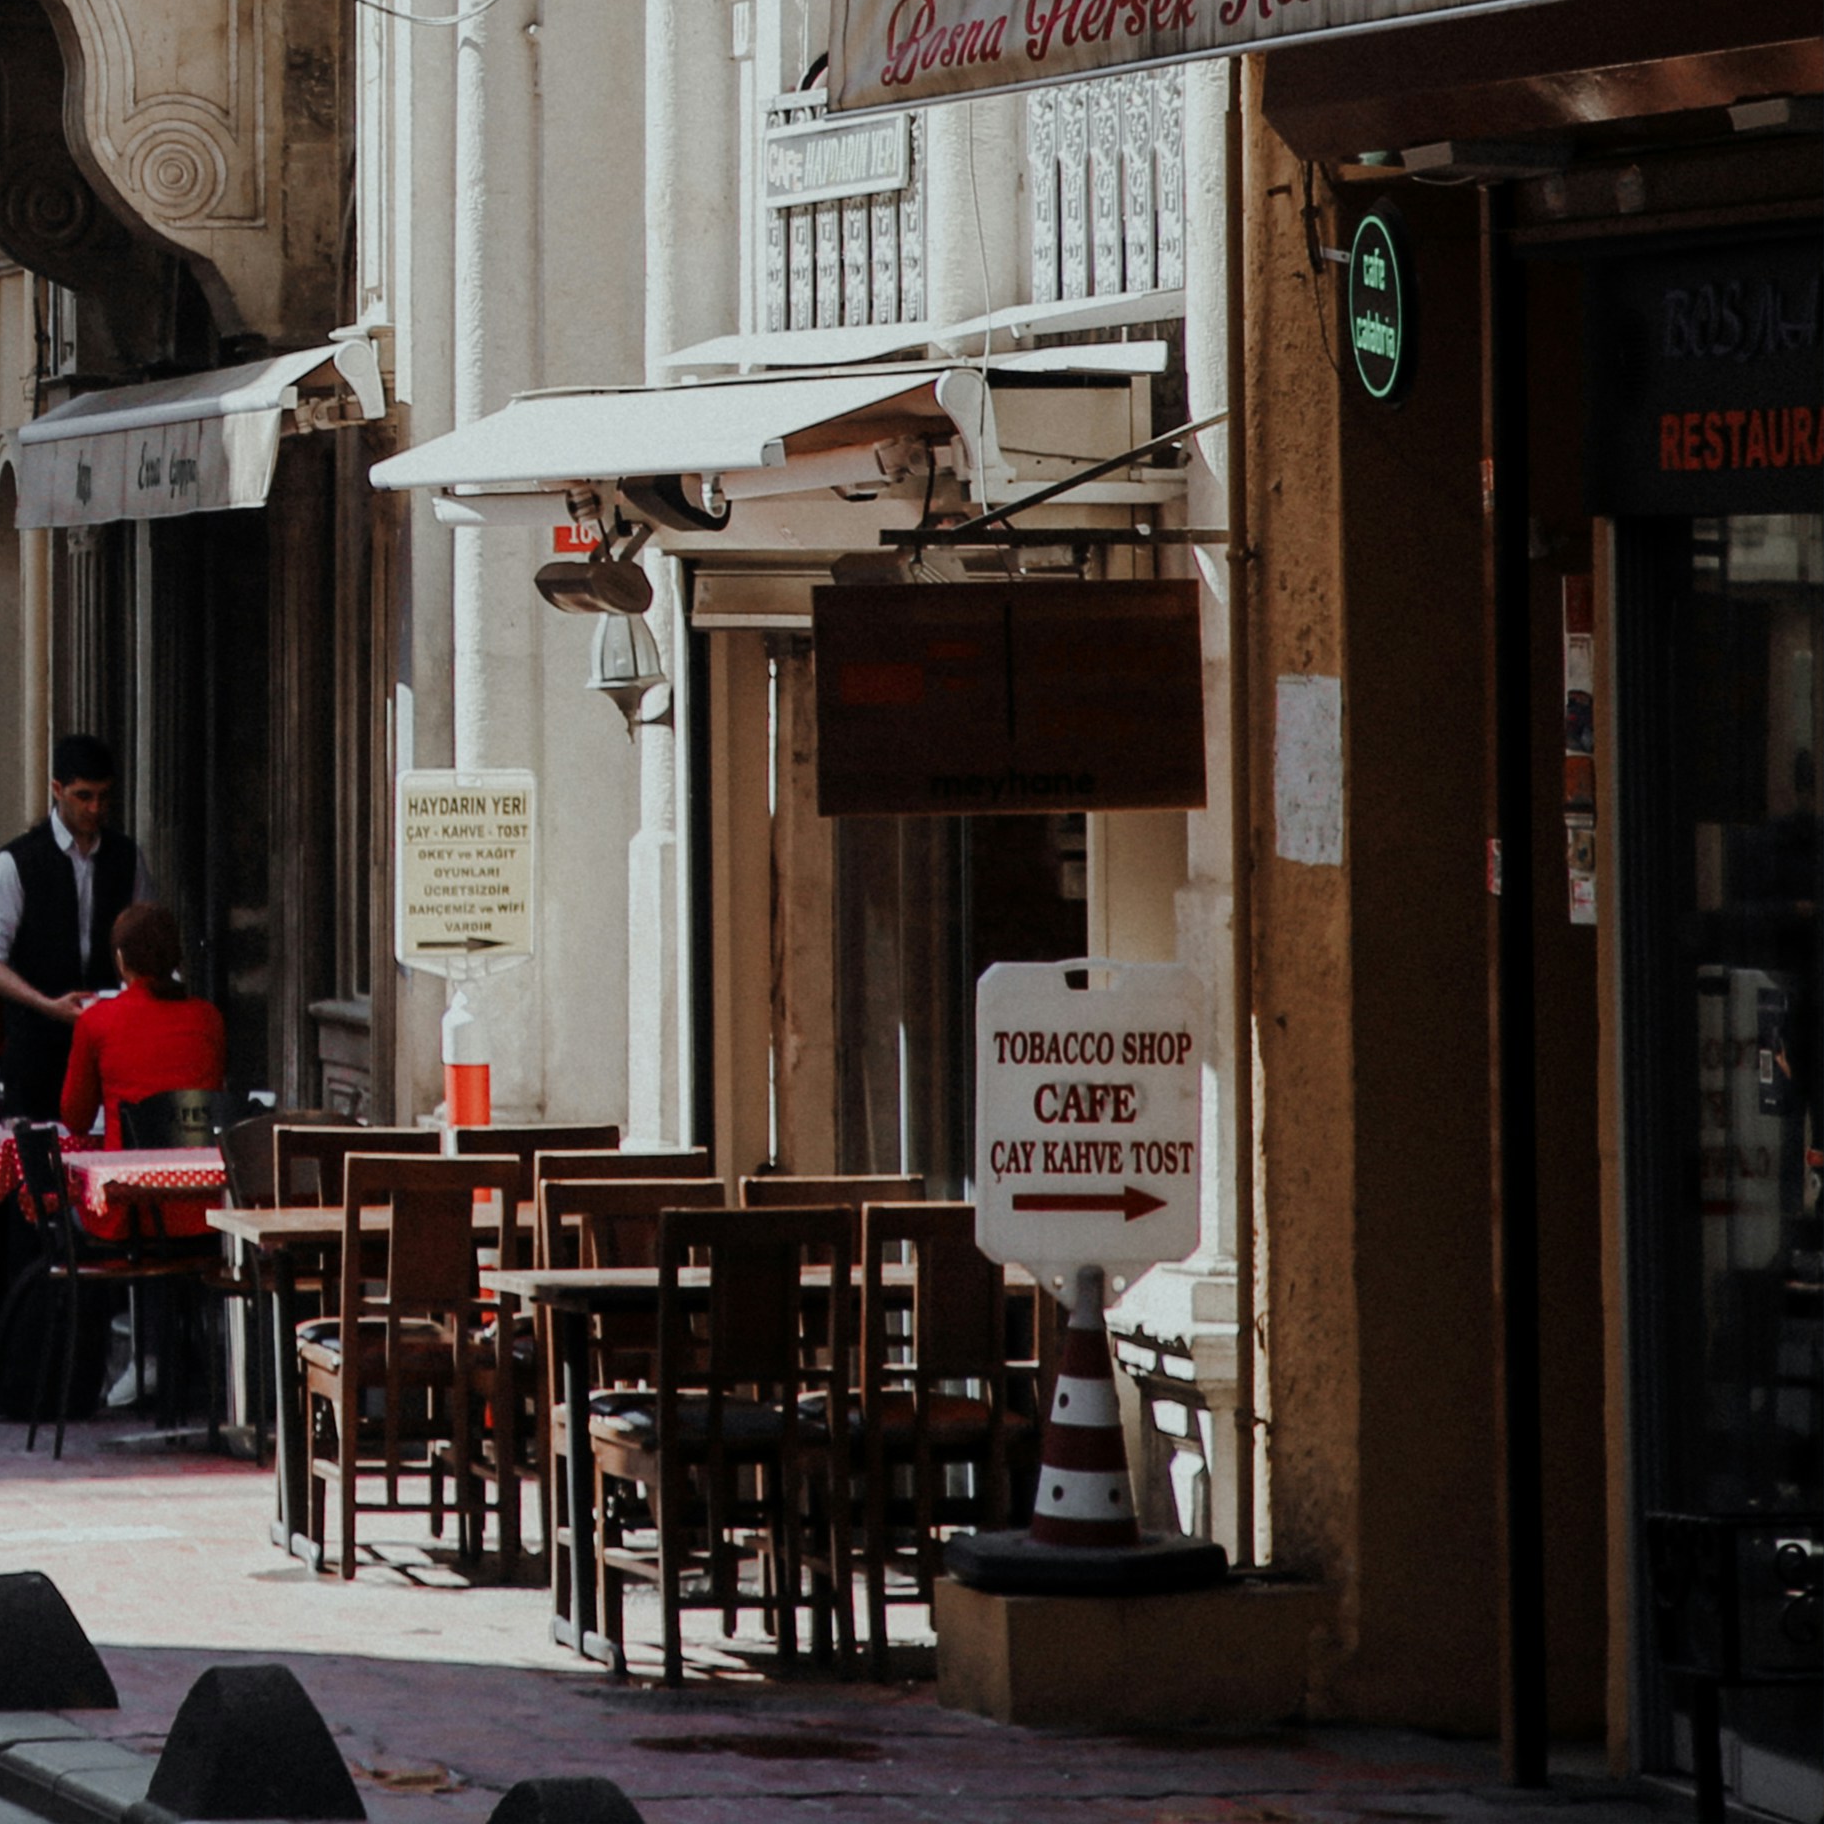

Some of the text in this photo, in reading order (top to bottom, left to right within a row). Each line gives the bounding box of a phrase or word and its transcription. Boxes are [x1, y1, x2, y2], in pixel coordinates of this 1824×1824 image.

[930, 766, 1096, 803] meyhane
[408, 791, 526, 817] HAYDARIN YERİ
[406, 825, 430, 844] ÇAY
[442, 825, 485, 838] KAHVE
[497, 825, 528, 838] TOST
[457, 851, 472, 860] ve
[479, 905, 494, 914] ve
[444, 922, 493, 932] VARDIR
[993, 1031, 1192, 1065] TOBACCO SHOP
[1034, 1083, 1137, 1124] CAFE
[990, 1140, 1194, 1184] ÇAY KAHVE TOST
